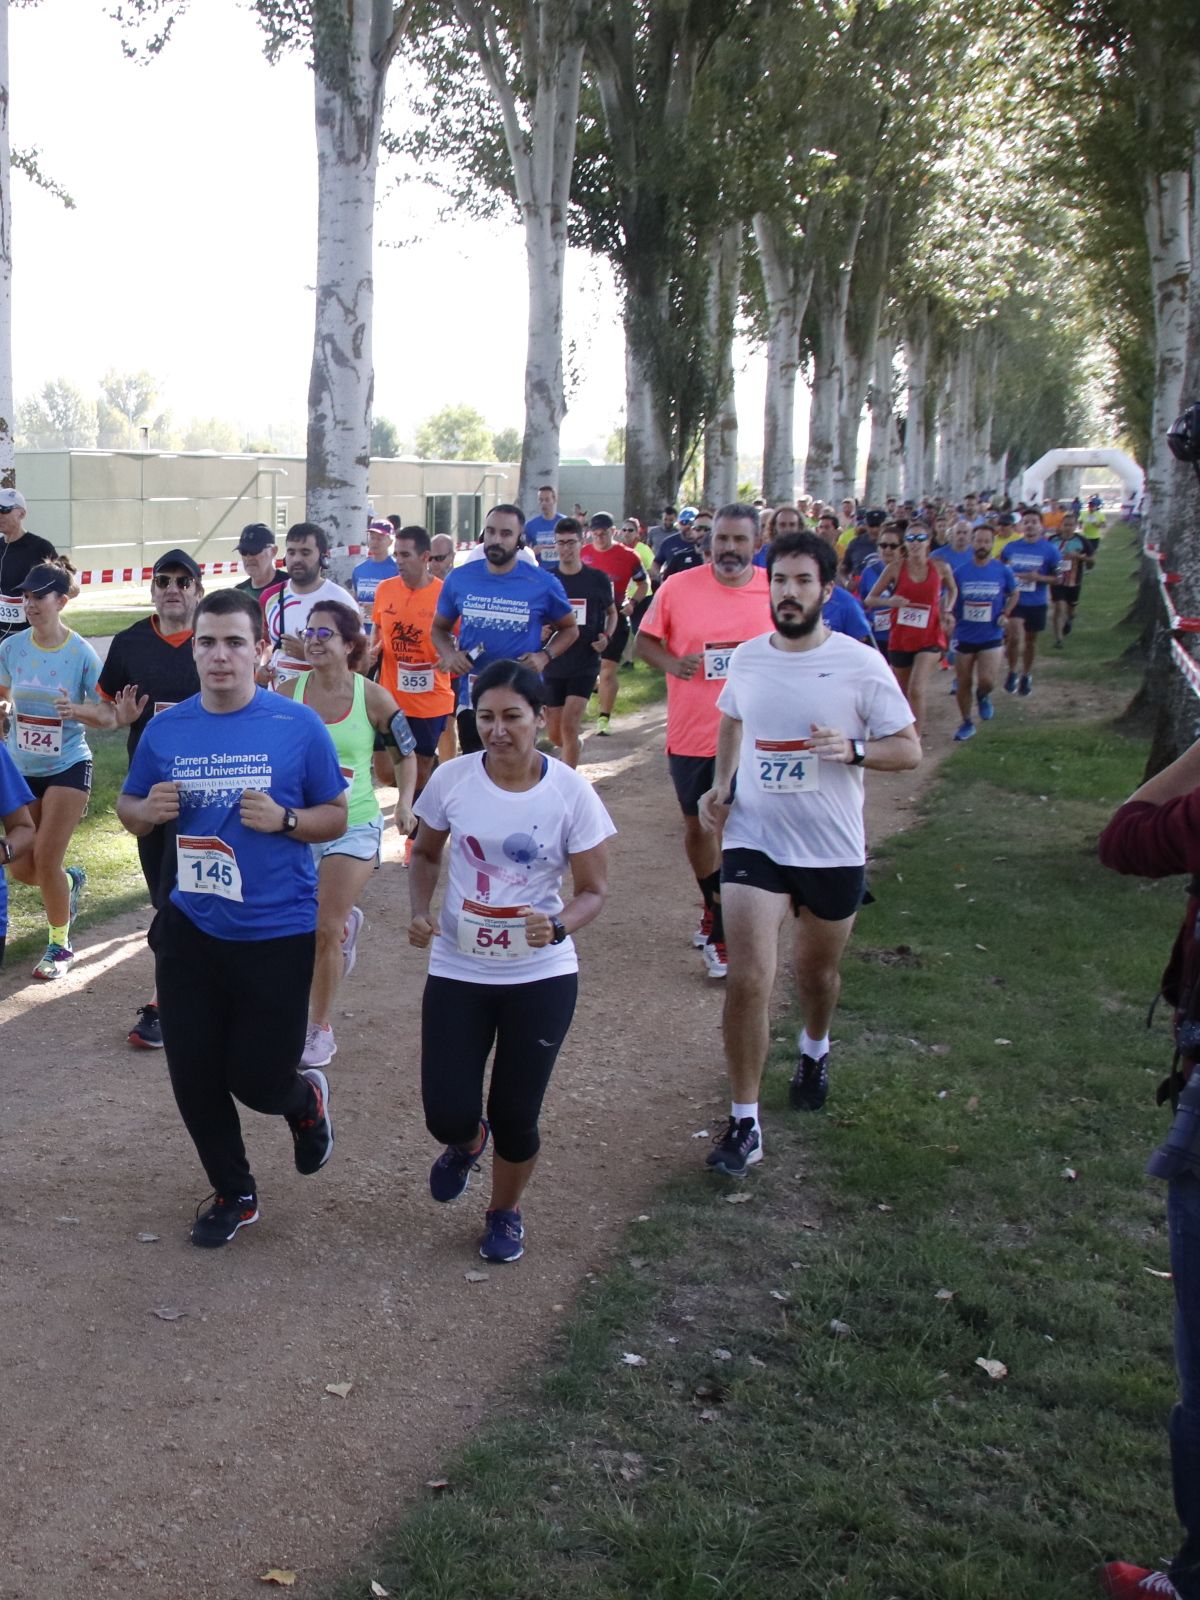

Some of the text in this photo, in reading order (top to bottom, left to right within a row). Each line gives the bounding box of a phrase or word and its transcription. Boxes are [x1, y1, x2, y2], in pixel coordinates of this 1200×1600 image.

[0, 607, 19, 618] 333
[463, 601, 530, 614] Ciudad Universitaria
[402, 676, 427, 687] 353
[23, 731, 52, 747] 124
[174, 753, 268, 766] Carrera Salamanca
[172, 764, 272, 778] Ciudad Universitaria
[760, 761, 805, 781] 274
[191, 861, 232, 886] 145
[476, 927, 511, 949] 54
